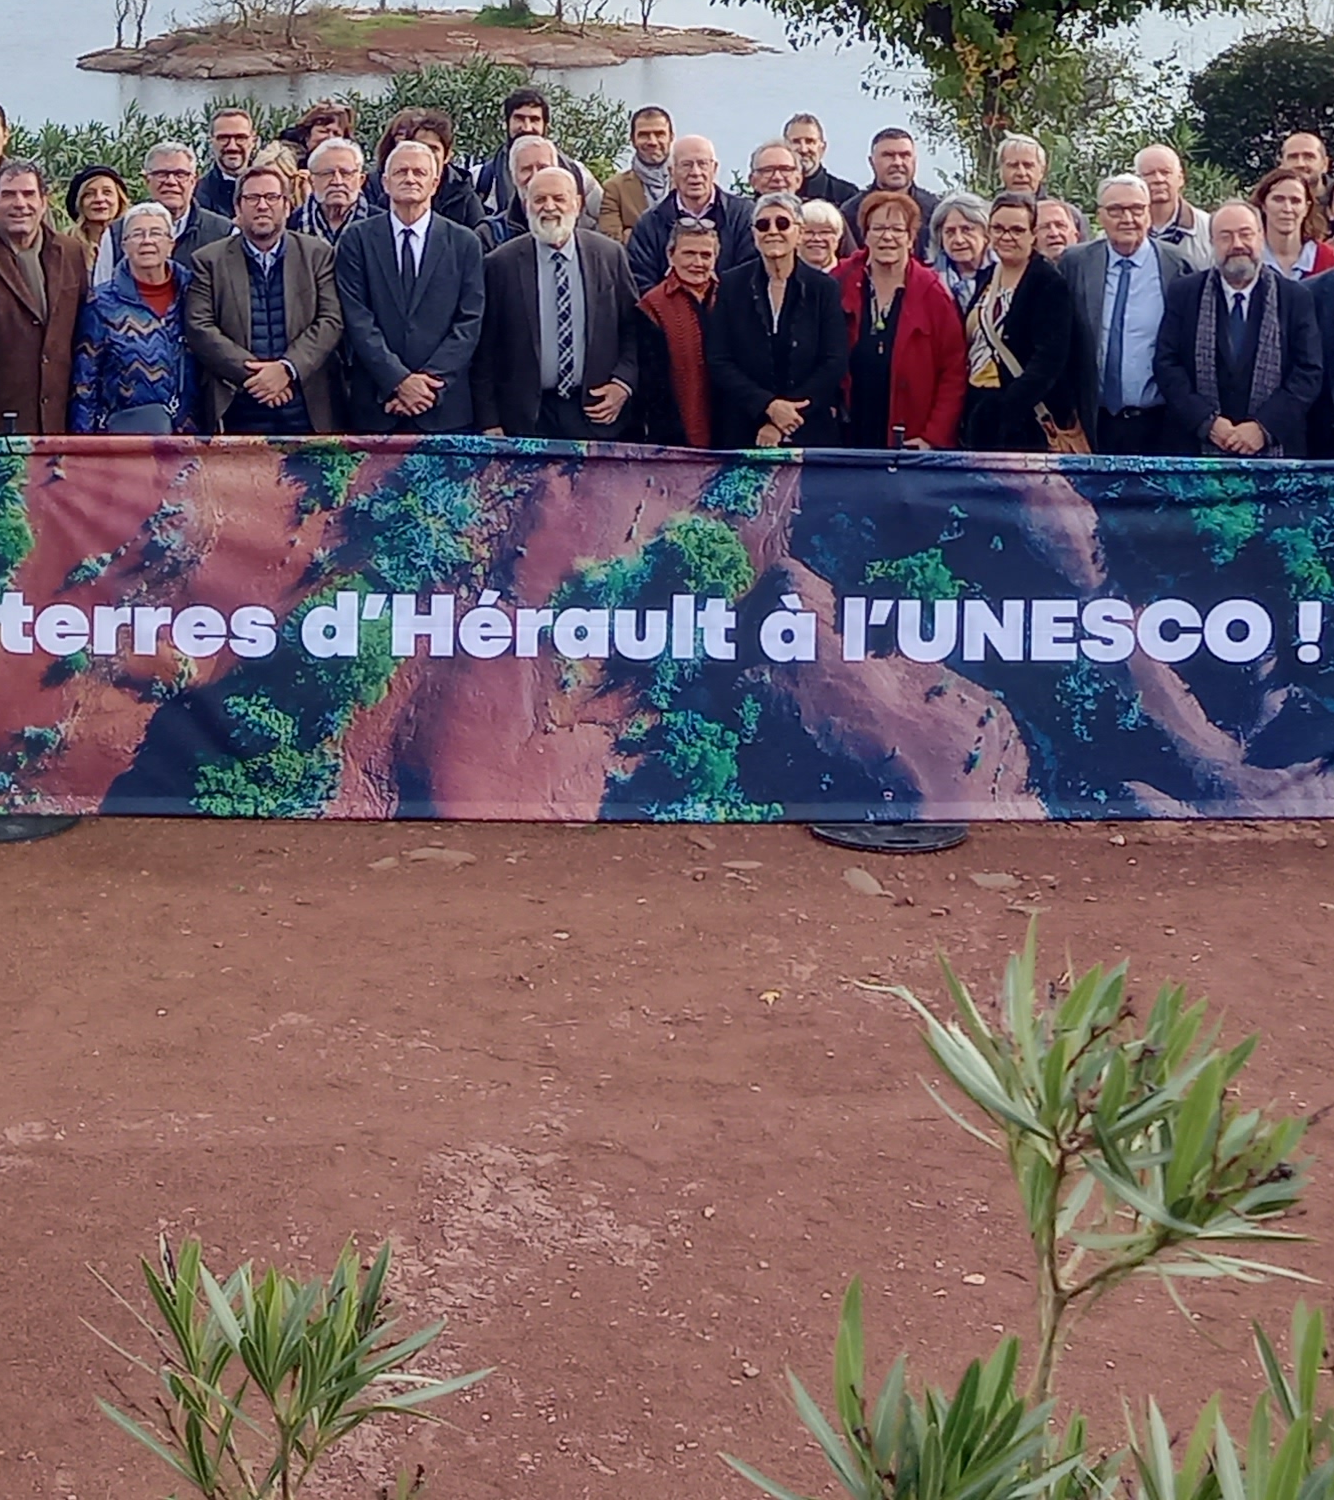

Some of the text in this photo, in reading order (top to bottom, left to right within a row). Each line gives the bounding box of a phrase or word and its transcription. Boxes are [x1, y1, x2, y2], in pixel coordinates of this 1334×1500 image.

[300, 589, 736, 660] d’Hérault
[759, 594, 818, 662] à
[841, 596, 1273, 663] l’UNESCO
[1296, 600, 1323, 663] !
